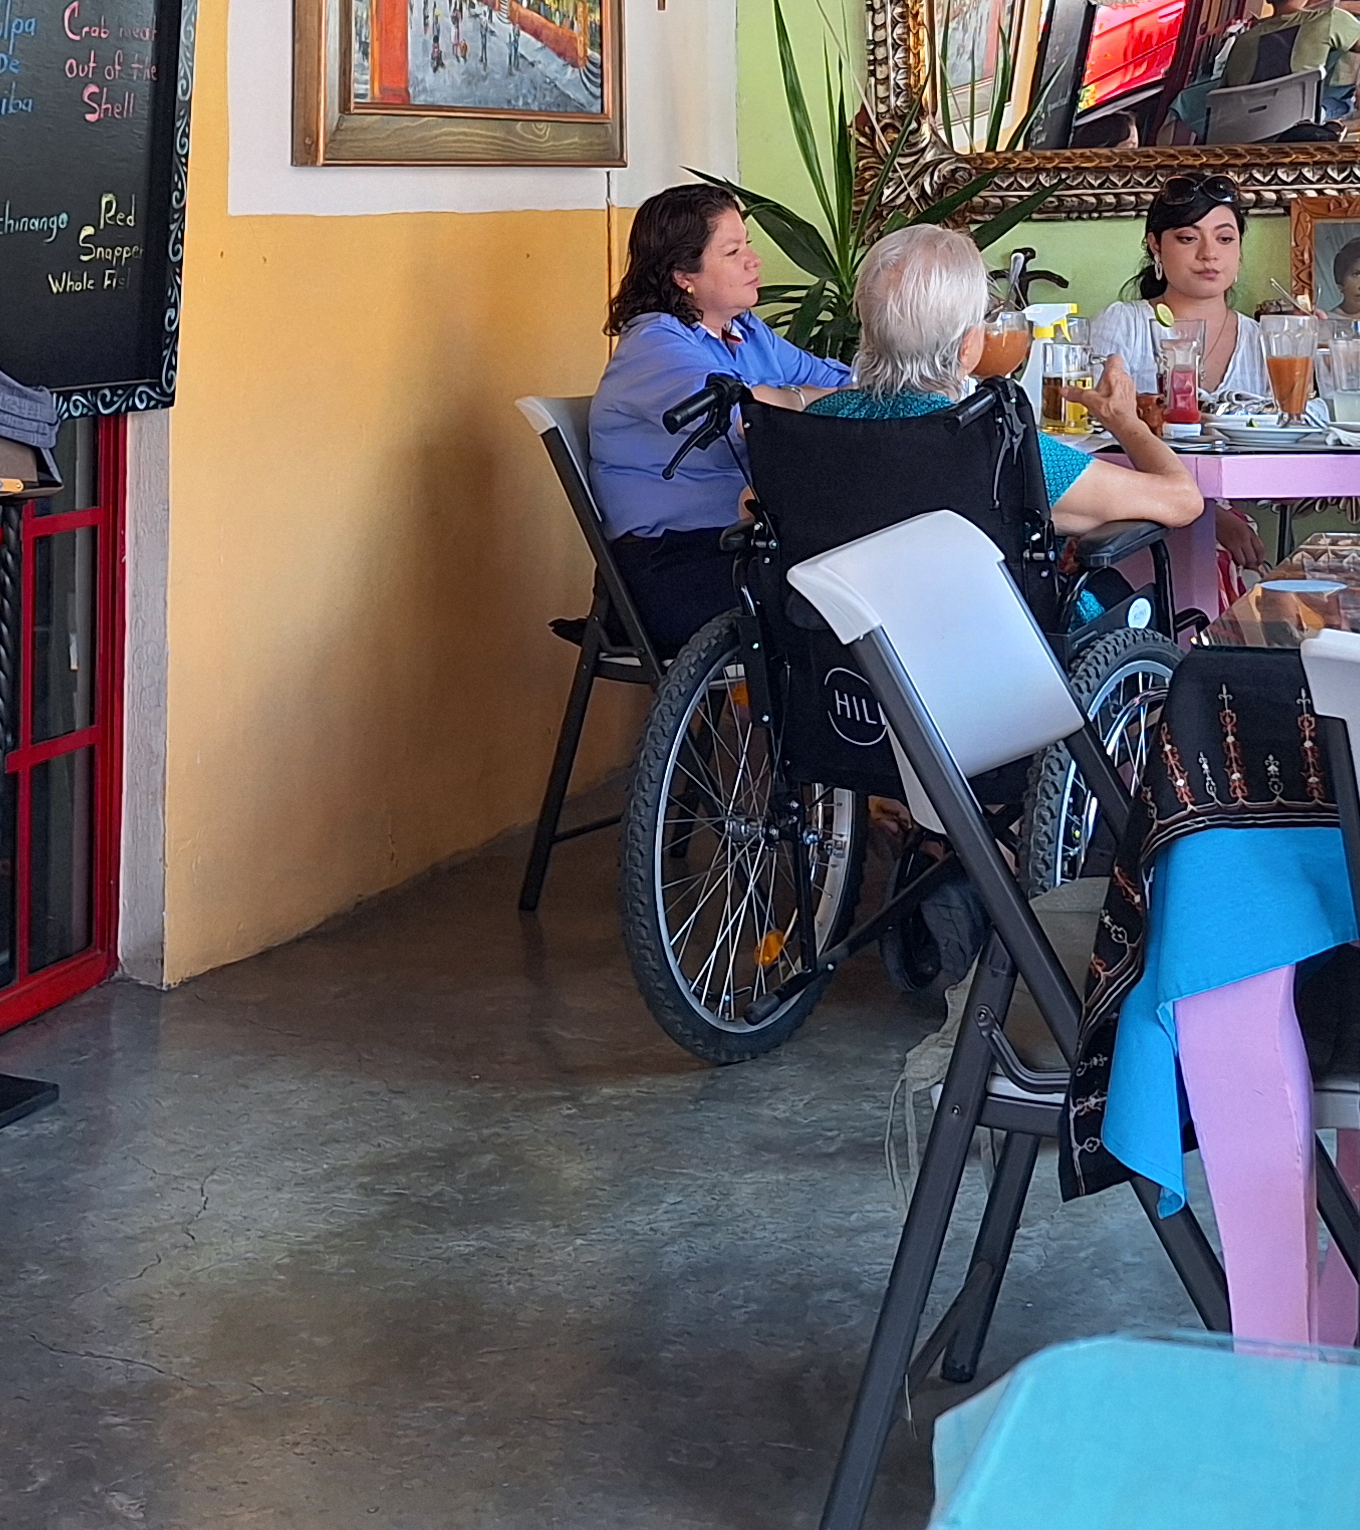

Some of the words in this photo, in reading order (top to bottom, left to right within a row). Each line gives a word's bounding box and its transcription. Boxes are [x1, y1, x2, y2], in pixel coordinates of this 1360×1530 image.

[63, 1, 110, 42] Crab
[104, 49, 124, 80] of
[82, 83, 135, 122] Shell
[99, 191, 137, 230] Red
[78, 225, 144, 267] Snapper
[47, 270, 95, 294] Whole
